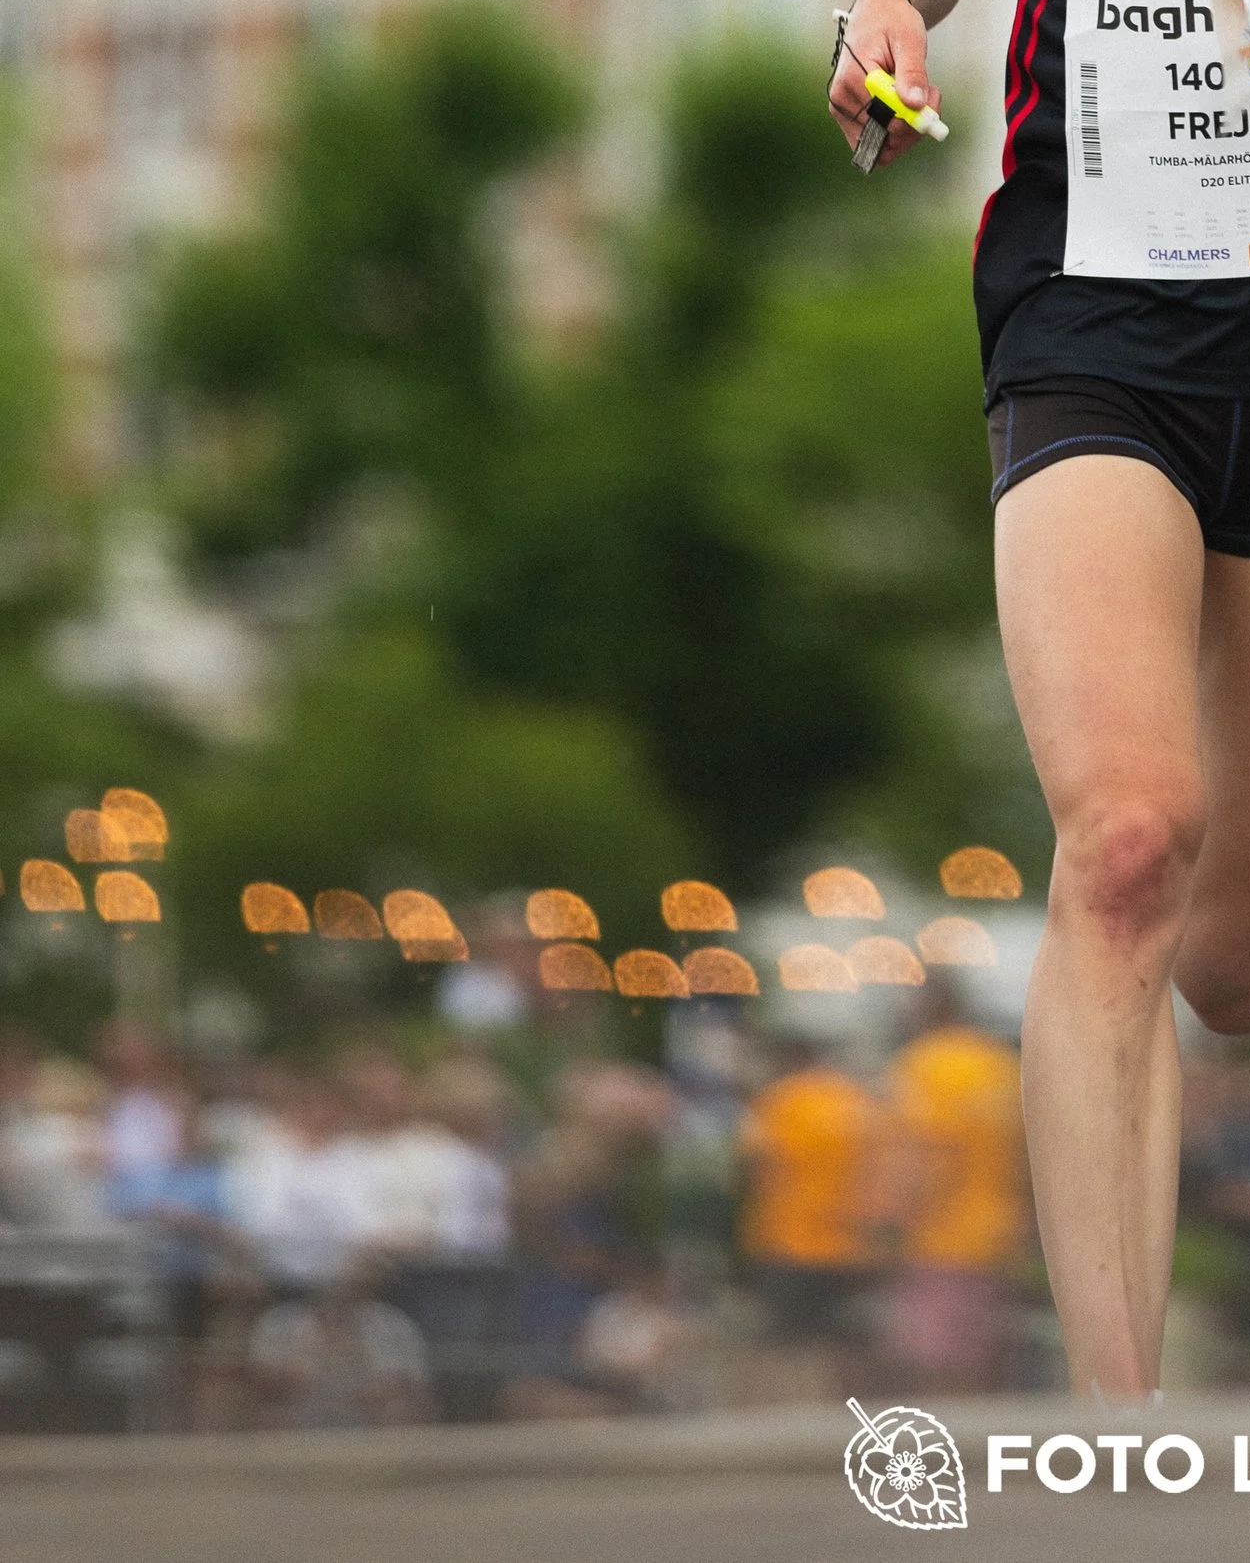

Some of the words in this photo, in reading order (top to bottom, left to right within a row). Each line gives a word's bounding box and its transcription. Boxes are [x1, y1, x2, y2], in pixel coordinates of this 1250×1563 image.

[1164, 61, 1225, 91] 140
[1201, 176, 1225, 188] D20
[1228, 174, 1250, 186] ELIT
[1148, 248, 1231, 261] CHALMERS
